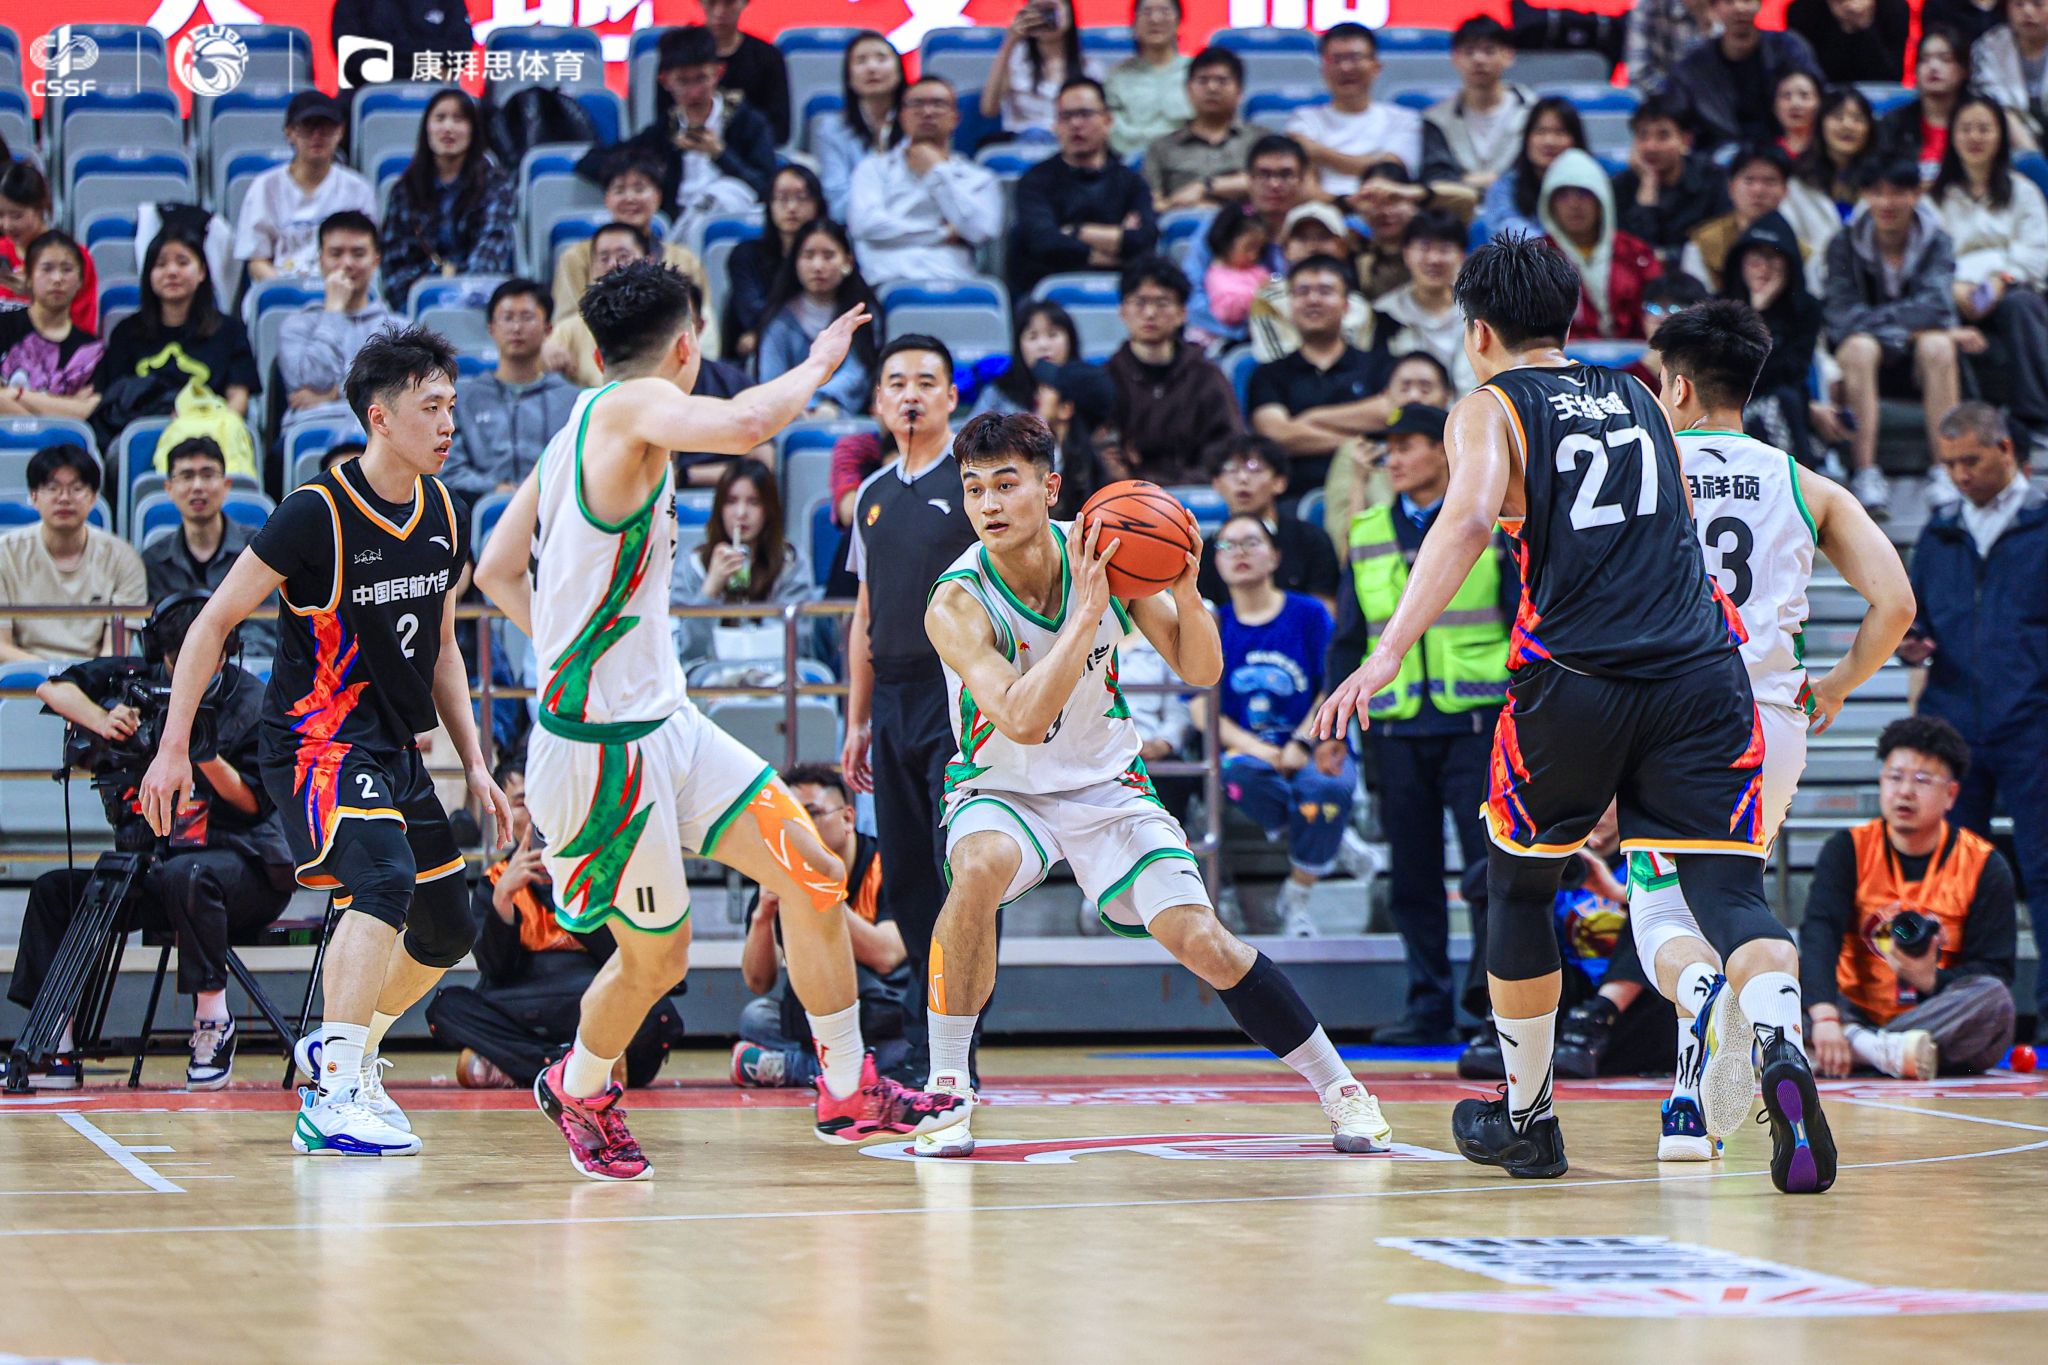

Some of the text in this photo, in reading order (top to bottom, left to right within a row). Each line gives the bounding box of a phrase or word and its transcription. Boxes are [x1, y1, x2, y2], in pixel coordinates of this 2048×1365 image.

[1555, 424, 1659, 531] 27
[1692, 516, 1754, 609] 3
[352, 568, 449, 606] 中国民航大学
[396, 613, 419, 660] 2
[355, 773, 380, 799] 2
[636, 886, 656, 913] 11
